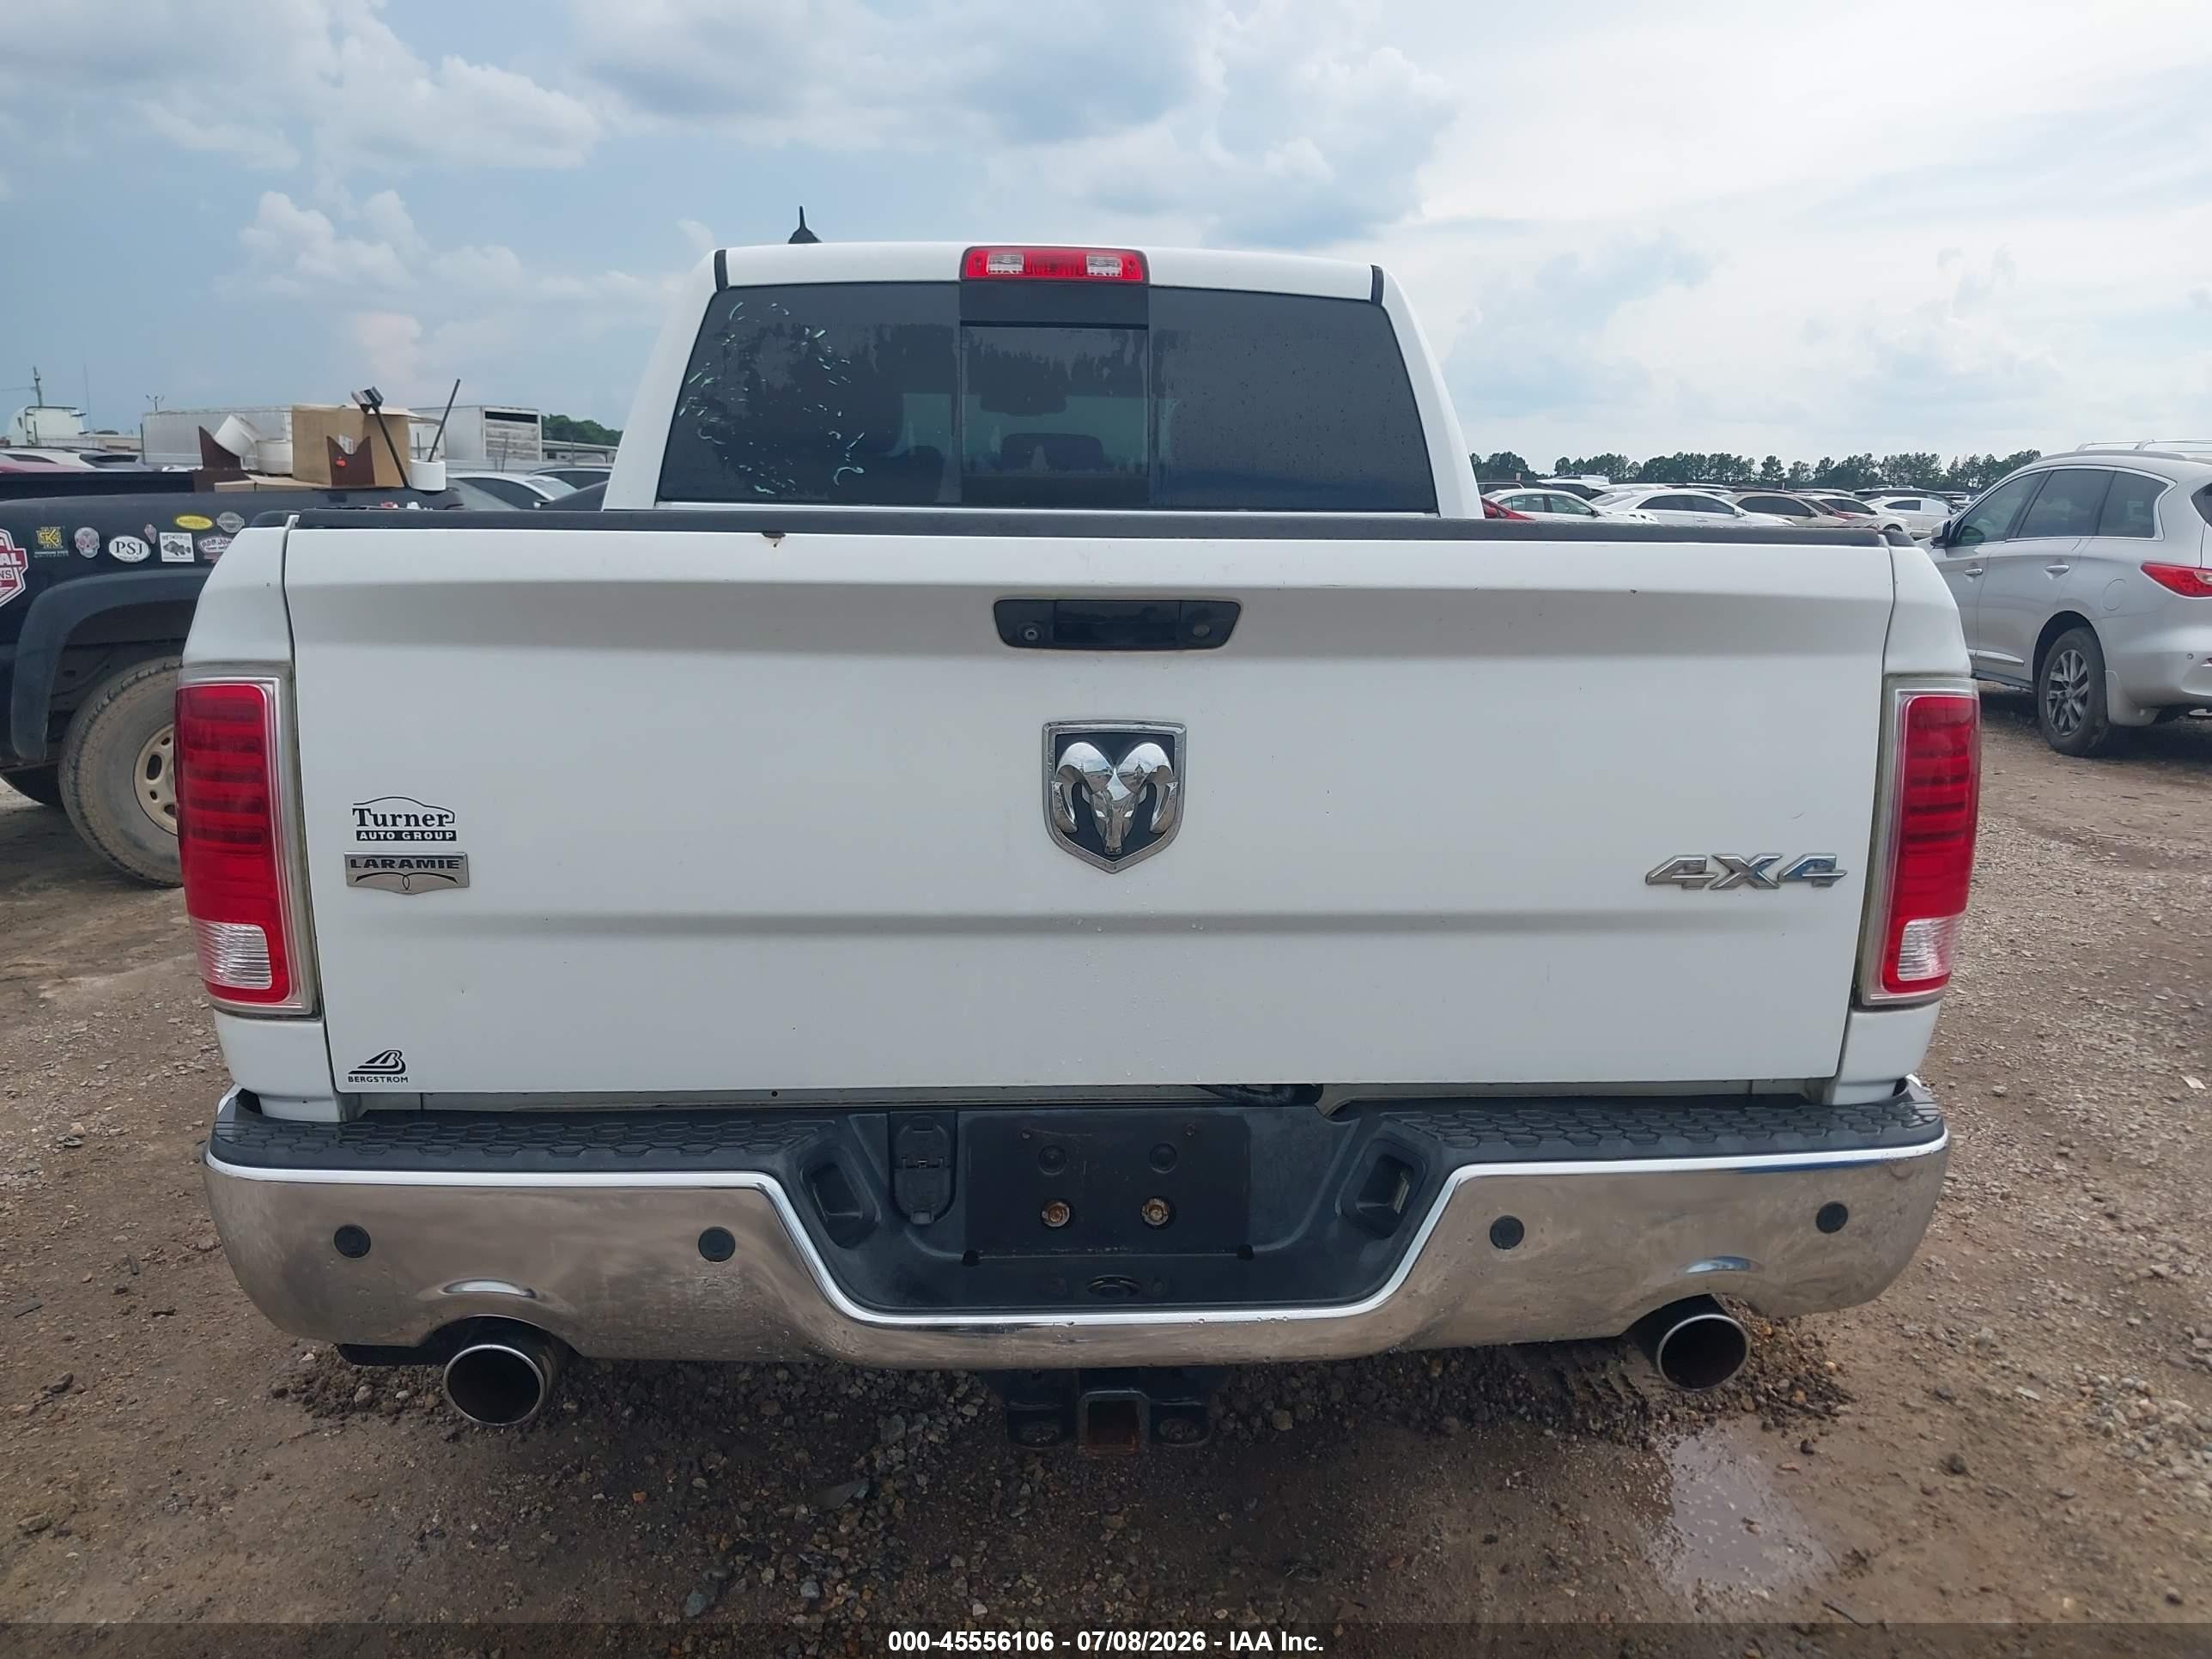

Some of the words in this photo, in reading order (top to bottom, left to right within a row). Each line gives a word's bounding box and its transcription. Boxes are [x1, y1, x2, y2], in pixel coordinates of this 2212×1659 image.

[114, 540, 143, 556] PSJ
[352, 808, 450, 827] Turner
[359, 831, 395, 840] AUTO
[402, 831, 453, 840] GROUP
[349, 859, 459, 869] LARAMIE
